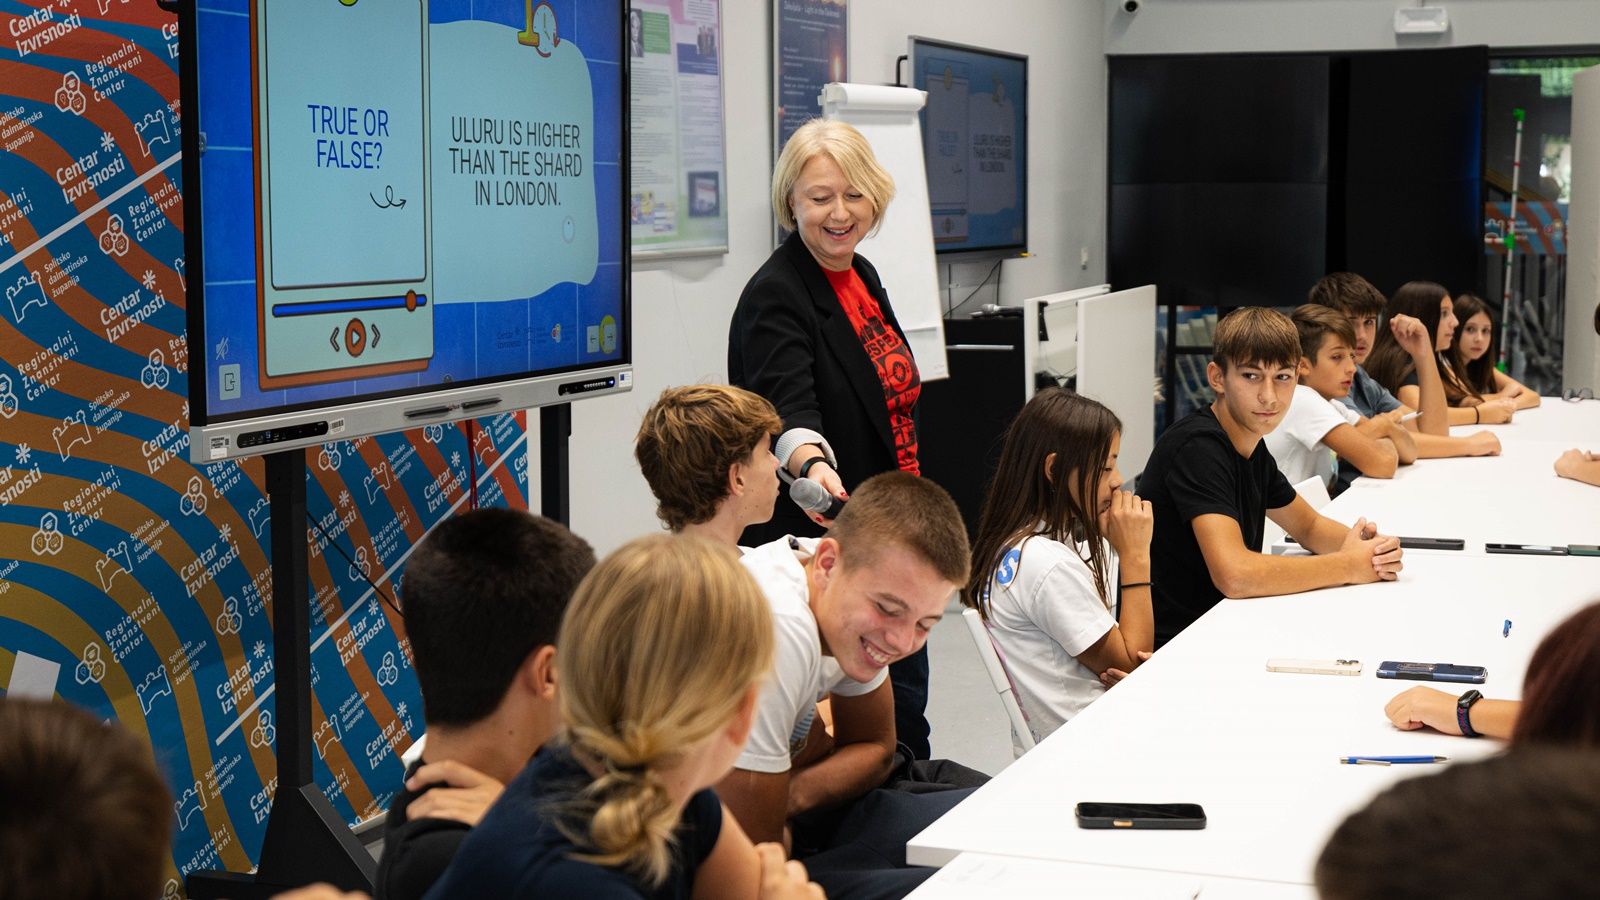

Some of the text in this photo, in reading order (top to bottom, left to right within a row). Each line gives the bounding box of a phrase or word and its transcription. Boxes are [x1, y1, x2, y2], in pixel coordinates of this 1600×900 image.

[9, 4, 53, 37] Centar
[16, 9, 81, 57] Izvrsnosti
[85, 39, 136, 75] Regionalni
[89, 52, 142, 88] Znanstveni
[94, 78, 126, 102] Centar
[1, 111, 43, 139] dalmatinska
[307, 104, 389, 137] TRUE OR
[451, 116, 581, 149] ULURU IS HIGHER
[6, 131, 34, 152] županija
[316, 139, 383, 169] FALSE?
[56, 150, 98, 185] Centar
[62, 153, 125, 205] Izvrsnosti
[449, 148, 582, 177] THAN THE SHARD
[128, 178, 177, 217] Regionalni
[132, 189, 182, 229] Znanstveni
[475, 180, 562, 206] IN LONDON.
[136, 218, 166, 242] Centar
[44, 251, 71, 273] Splitsko
[48, 255, 88, 285] dalmatinska
[100, 289, 141, 326] Centar
[106, 289, 166, 343] Izvrsnosti
[17, 331, 73, 376] Regionalni
[22, 342, 79, 389] Znanstveni
[27, 372, 61, 401] Centar
[88, 389, 114, 412] Splitsko
[92, 390, 131, 423] dalmatinska
[142, 419, 181, 458] Centar
[147, 434, 190, 475] Izvrsno
[63, 465, 116, 513] Regionalni
[67, 475, 122, 526] Znanstveni
[213, 472, 241, 499] Centar
[424, 467, 450, 499] Centar
[428, 466, 467, 513] Izvrsnosti
[71, 507, 104, 537] Centar
[130, 518, 155, 542] Splitsko
[133, 519, 170, 553] dalmatinska
[371, 506, 406, 546] Regionalni
[373, 515, 410, 556] Znanstveni
[180, 542, 217, 583] Centar
[185, 540, 240, 598] Izvrsnosti
[376, 541, 398, 565] Centar
[105, 592, 155, 642] Regionalni
[109, 602, 161, 653] Znanstveni
[336, 616, 367, 653] Centar
[113, 633, 144, 664] Centar
[168, 640, 192, 665] Splitsko
[340, 613, 386, 668] Izvrsnosti
[216, 660, 252, 700] Centar
[221, 655, 274, 715] Izvrsnosti
[365, 719, 396, 757] Centar
[369, 715, 414, 770] Izvrsnosti
[181, 824, 227, 877] Regionalni
